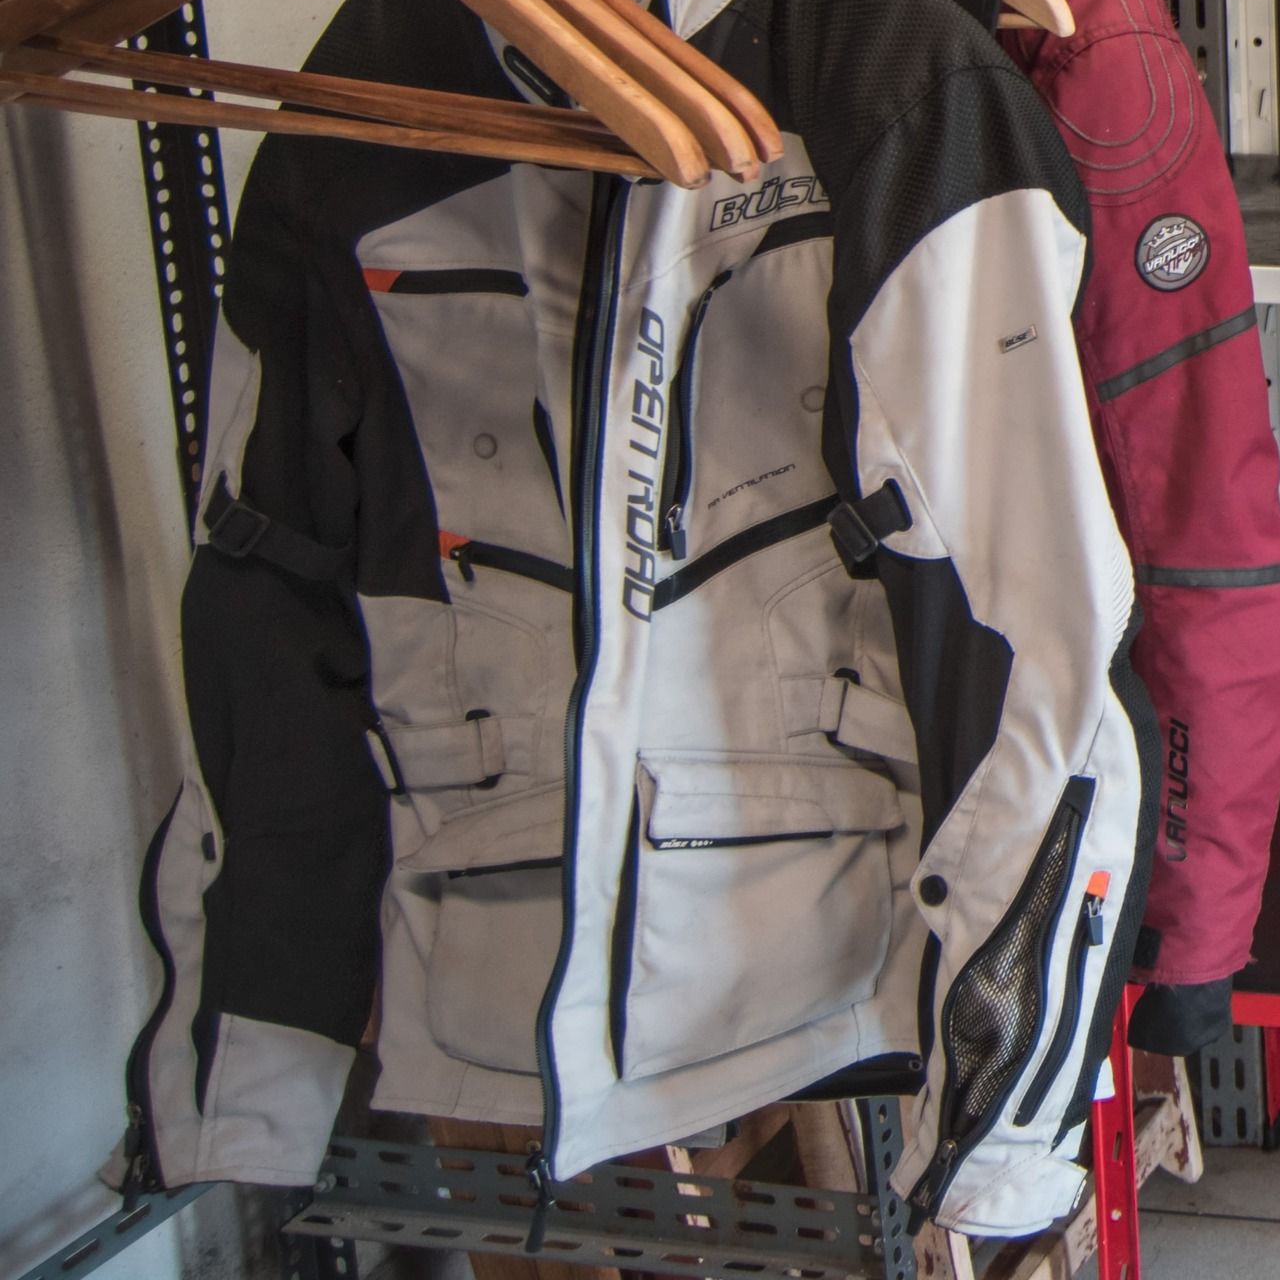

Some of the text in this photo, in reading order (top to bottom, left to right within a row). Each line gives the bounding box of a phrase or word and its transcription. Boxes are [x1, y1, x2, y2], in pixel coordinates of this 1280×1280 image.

[622, 307, 665, 623] OPEN ROAD
[1167, 718, 1189, 861] VANUCCI
